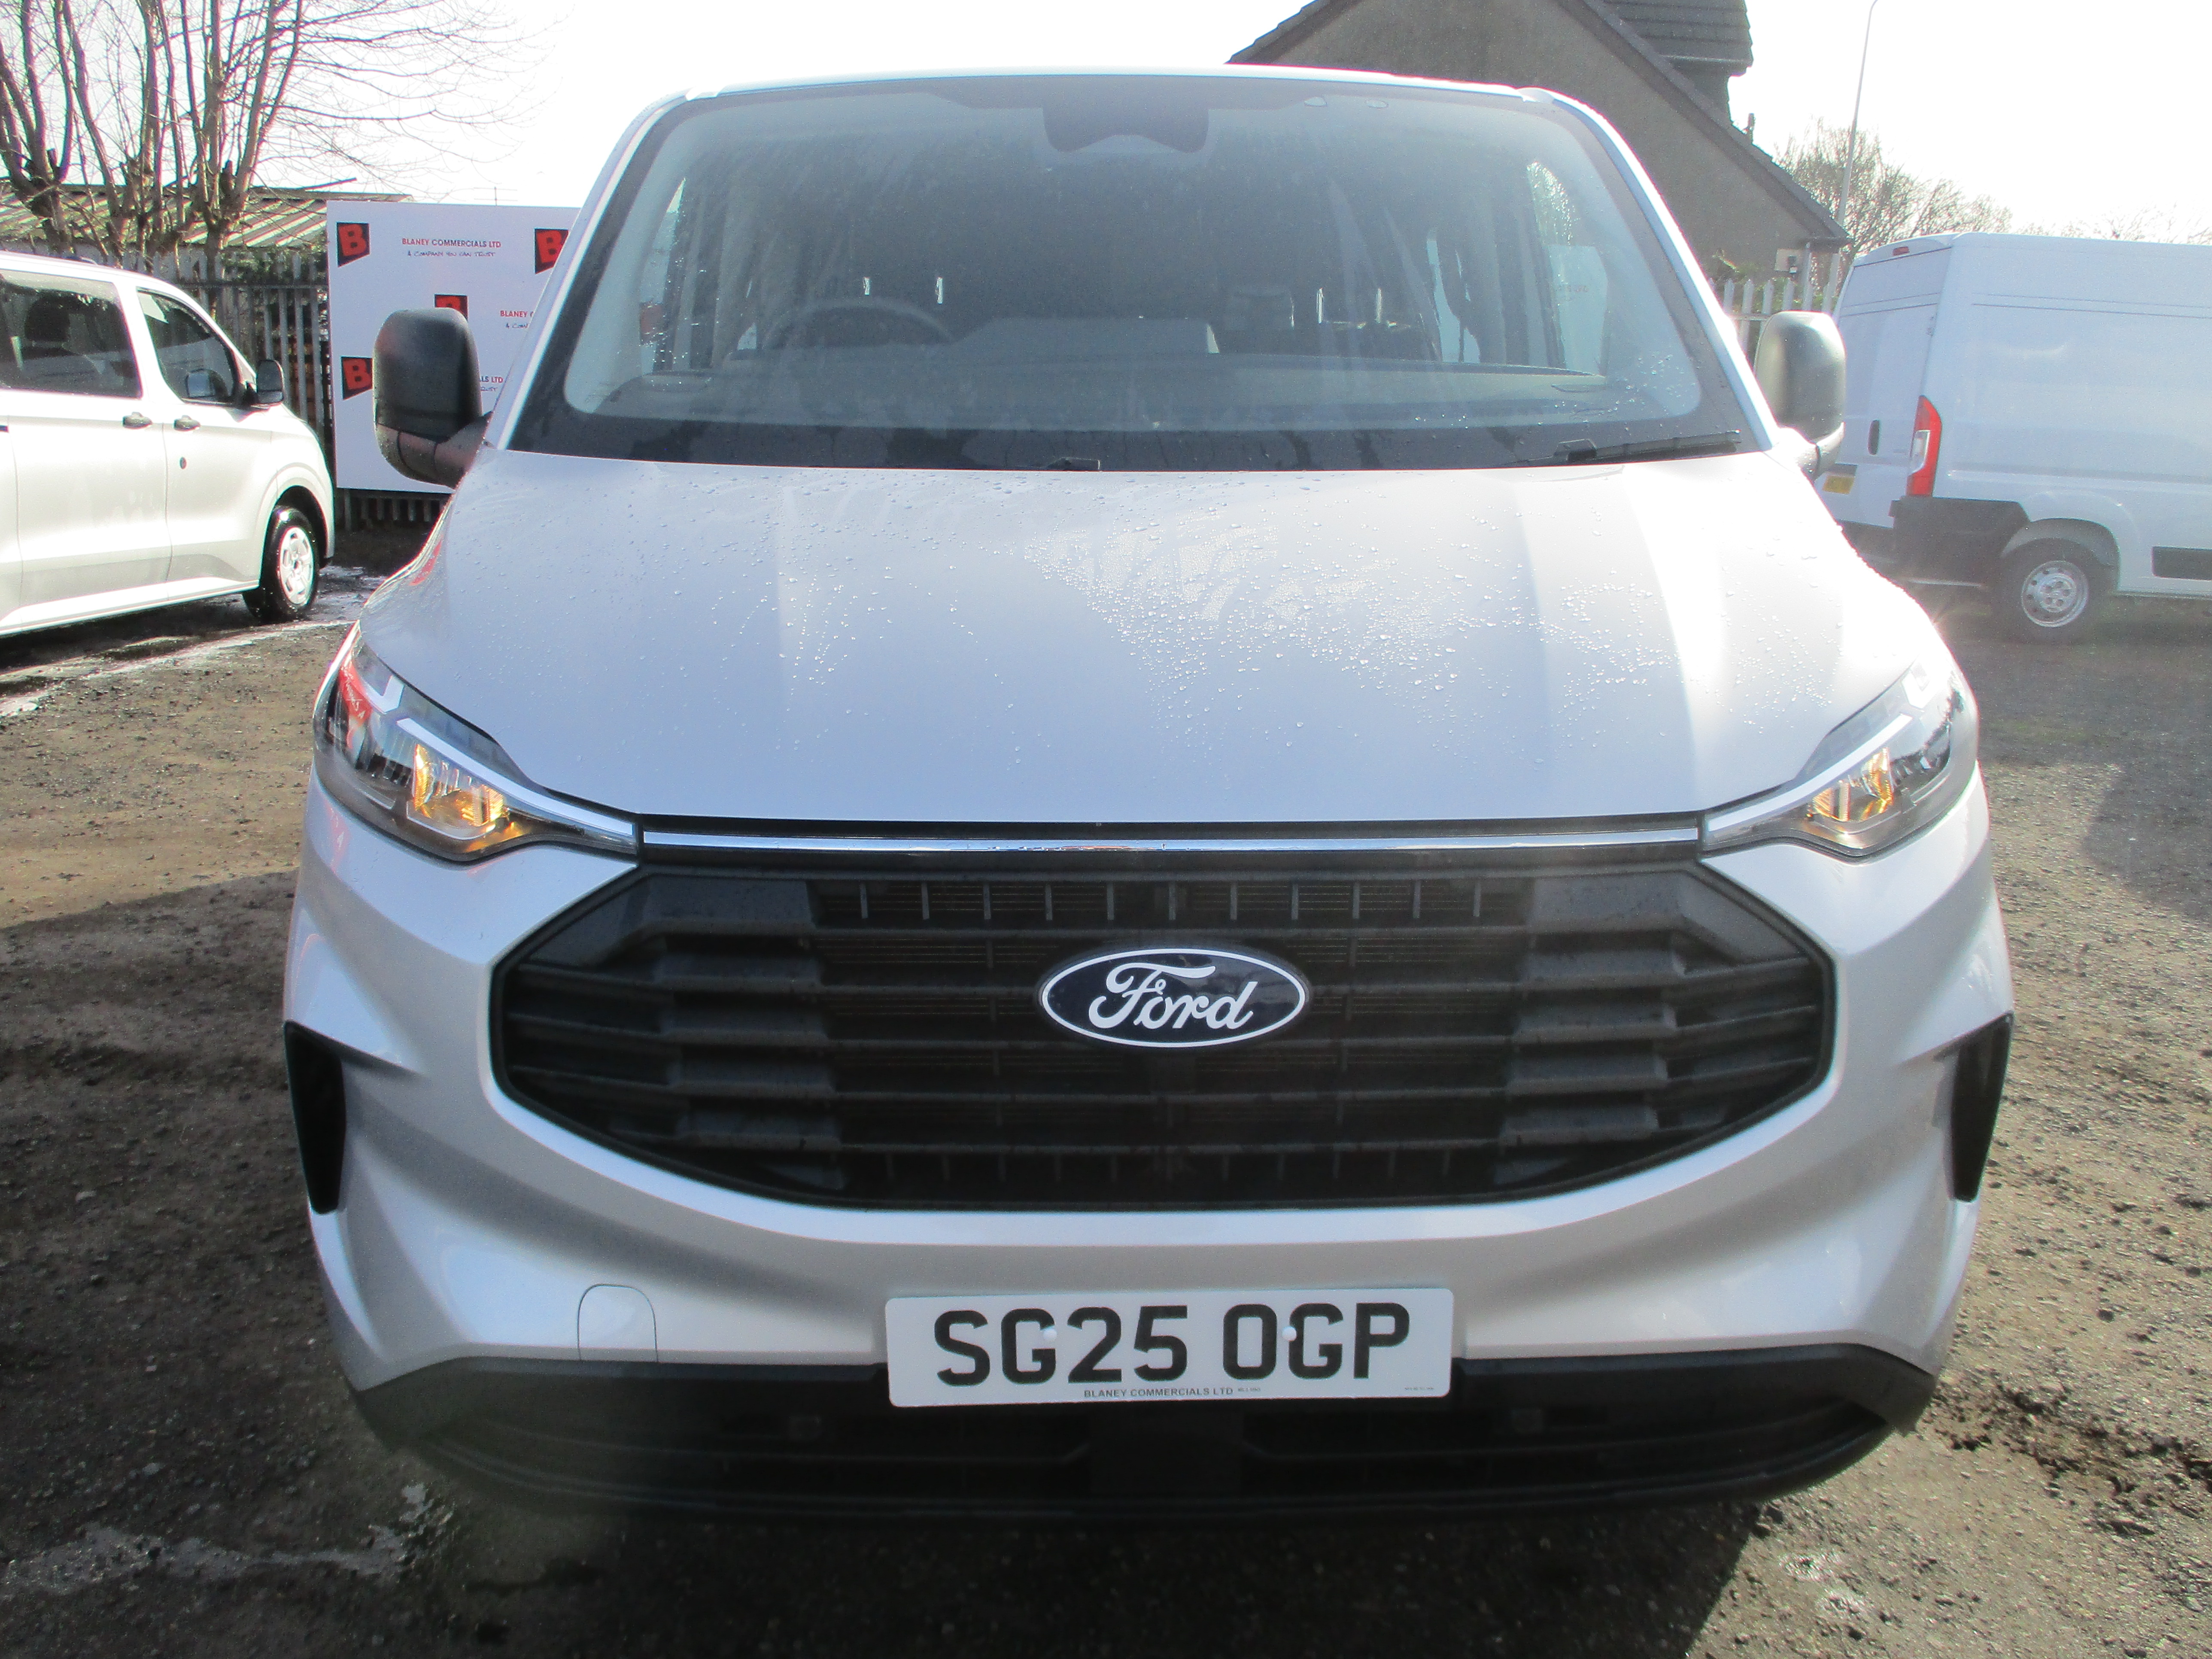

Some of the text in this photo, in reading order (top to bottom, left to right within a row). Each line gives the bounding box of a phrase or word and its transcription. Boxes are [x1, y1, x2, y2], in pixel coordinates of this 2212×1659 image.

[338, 224, 367, 256] B
[431, 239, 487, 247] COMMERCIALS
[343, 359, 372, 390] B
[1089, 962, 1258, 1030] Ford
[934, 1302, 1410, 1386] SG25 OGP
[1084, 1389, 1127, 1398] BLANEY
[1130, 1387, 1209, 1396] COMMERCIALS
[1213, 1387, 1234, 1395] LTD
